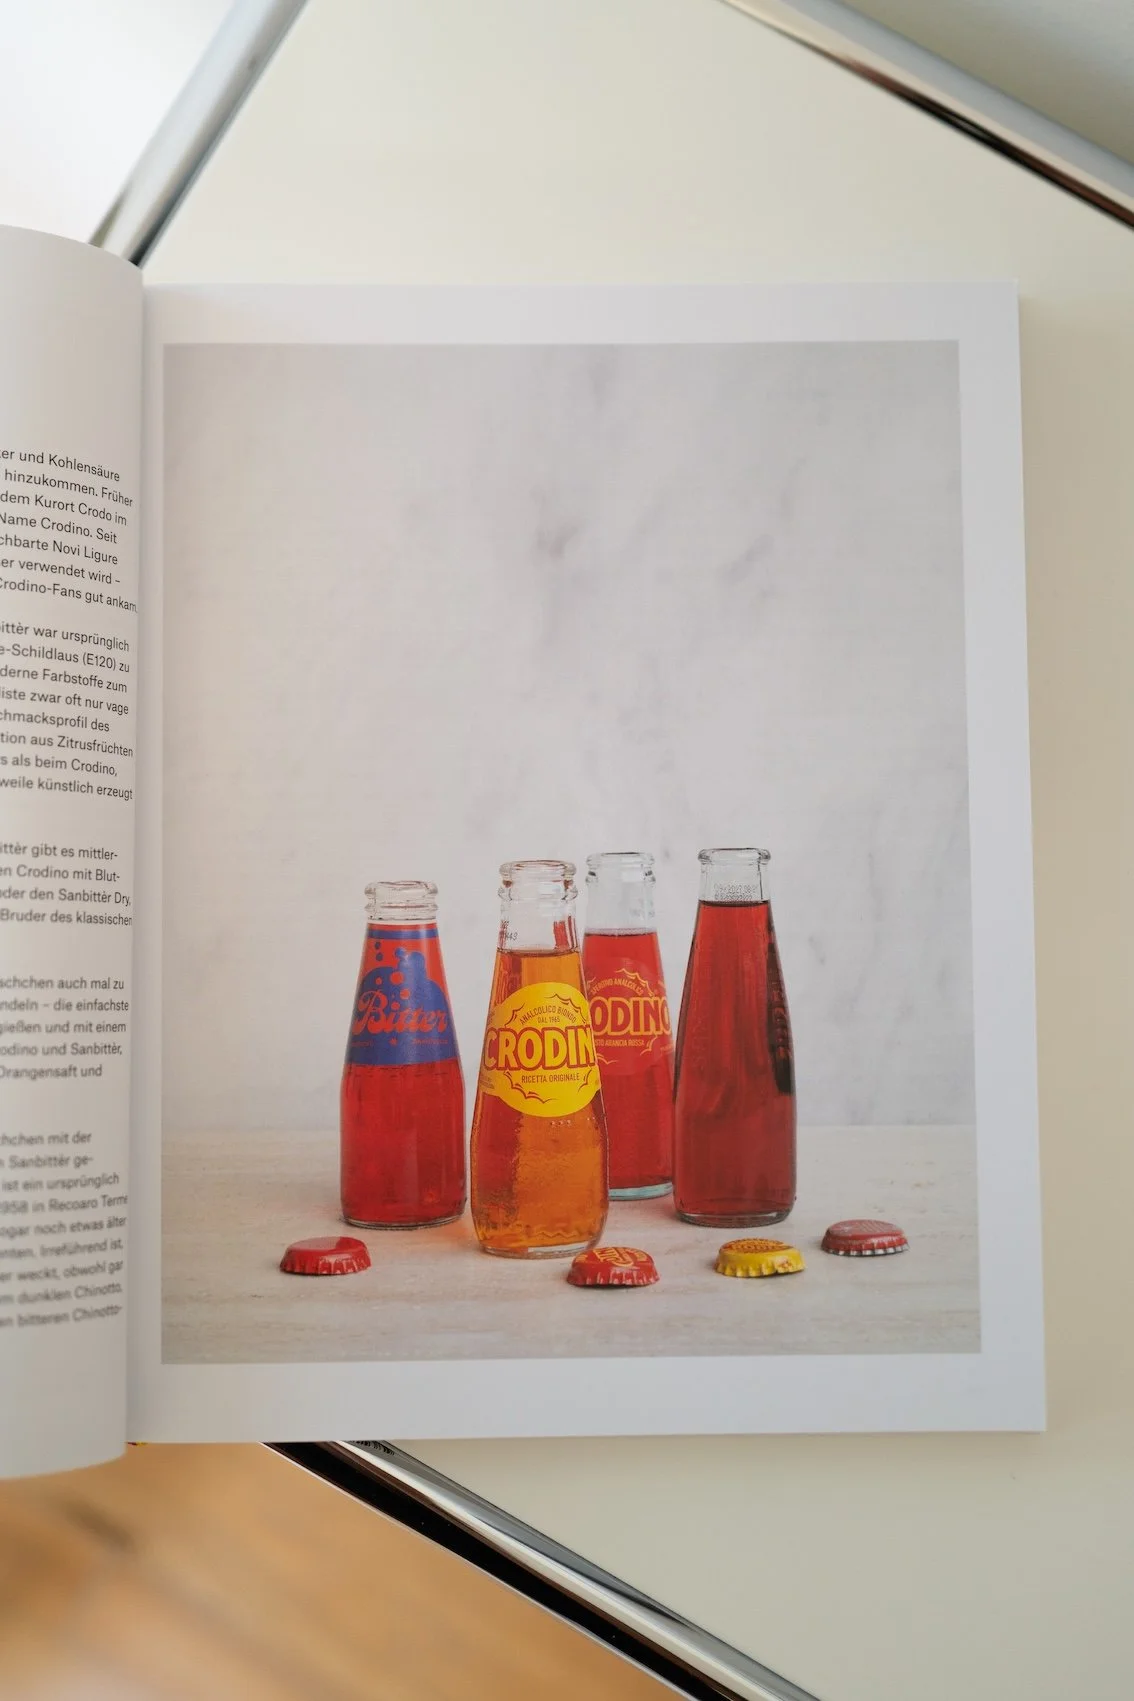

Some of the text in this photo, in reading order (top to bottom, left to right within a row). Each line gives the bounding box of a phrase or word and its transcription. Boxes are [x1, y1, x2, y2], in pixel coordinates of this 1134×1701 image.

[0, 450, 120, 482] er und Kohlensäure
[5, 469, 133, 507] hinzukommen. Früher
[0, 491, 127, 526] dem Kurort Crodo im
[0, 513, 117, 544] Name Crodino. Seit
[53, 540, 80, 556] Novi
[84, 546, 118, 565] Ligure
[18, 560, 85, 578] verwendet
[88, 571, 112, 584] wird
[85, 592, 103, 604] gut
[33, 626, 58, 638] war
[62, 630, 129, 652] ursprünglich
[82, 652, 116, 671] (E120)
[119, 662, 130, 673] zu
[0, 665, 127, 693] derne Farbstoffe zum
[30, 692, 61, 704] zwar
[65, 694, 82, 706] oft
[85, 698, 103, 709] nur
[107, 702, 129, 715] vage
[91, 719, 109, 732] des
[0, 732, 133, 758] tion aus Zitrusfrüchten
[12, 753, 30, 767] als
[35, 756, 67, 769] beim
[71, 758, 117, 776] Crodino,
[0, 776, 133, 801] weile künstlich erzeugt
[31, 843, 57, 858] gibt
[61, 846, 74, 857] es
[78, 846, 118, 861] mittler-
[16, 864, 69, 879] Crodino
[73, 869, 91, 881] mit
[96, 869, 120, 883] Blut-
[29, 887, 54, 901] den
[58, 888, 112, 904] Sanbittèr
[114, 892, 131, 907] Dry,
[0, 908, 132, 926] Bruder des klassischen
[57, 977, 87, 990] auch
[90, 977, 110, 990] mal
[113, 981, 124, 991] zu
[53, 999, 73, 1011] die
[76, 999, 129, 1012] einfachste
[352, 989, 448, 1034] Bitter
[520, 1006, 576, 1025] ANALCOLICO BIONDO
[45, 1020, 70, 1034] und
[73, 1020, 93, 1033] mit
[96, 1021, 126, 1033] einem
[42, 1043, 67, 1056] und
[70, 1042, 122, 1056] Sanbittèr,
[81, 1064, 102, 1078] und
[522, 1072, 580, 1083] RICETTA ORIGINALE
[48, 1132, 69, 1145] mit
[72, 1130, 92, 1144] der
[74, 1155, 94, 1169] ge-
[2, 1172, 119, 1191] ist ein ursprünglich
[32, 1200, 45, 1212] in
[49, 1198, 98, 1211] Recoaro
[34, 1221, 67, 1235] noch
[70, 1221, 104, 1233] etwas
[106, 1216, 127, 1229] älter
[64, 1261, 106, 1279] obwohl
[108, 1260, 124, 1275] gar
